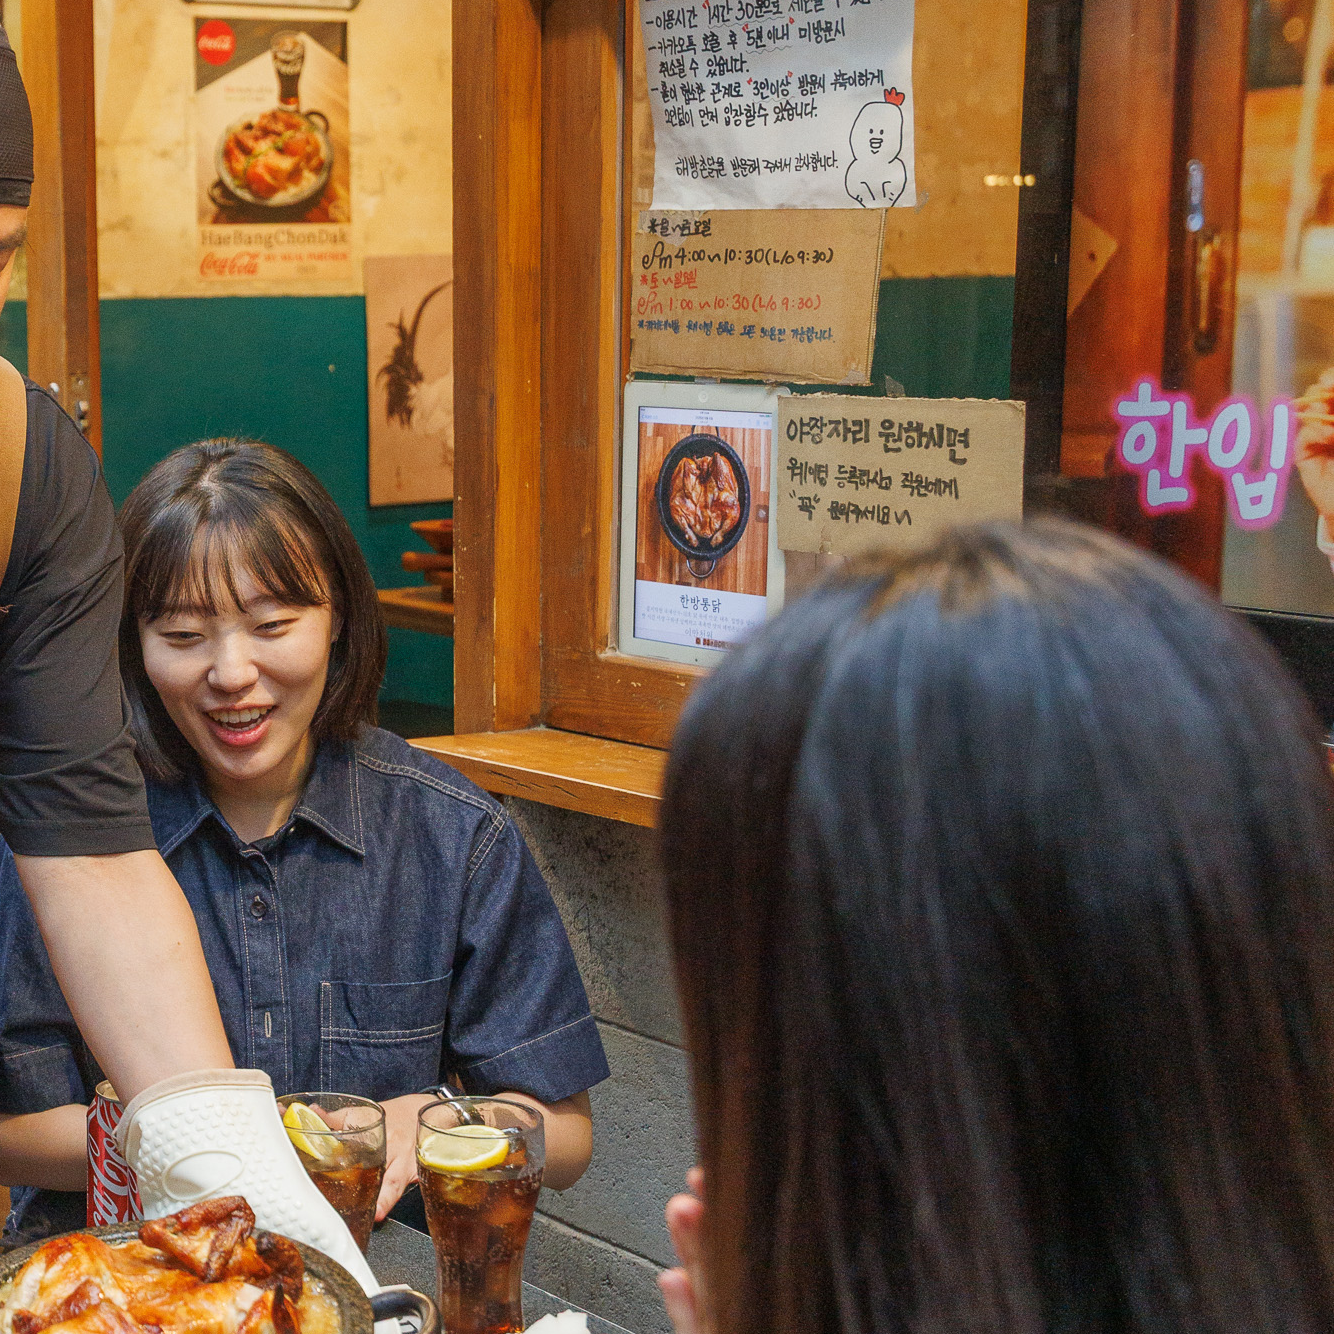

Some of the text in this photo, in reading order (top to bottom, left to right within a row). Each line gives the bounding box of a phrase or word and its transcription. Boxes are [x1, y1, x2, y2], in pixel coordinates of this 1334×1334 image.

[726, 29, 738, 50] 후
[797, 16, 846, 46] 미방문시
[688, 59, 700, 77] 수
[705, 53, 750, 78] 있습니다.
[710, 81, 744, 103] 관계로
[797, 73, 826, 97] 방문시
[698, 107, 719, 128] 먼저
[773, 99, 818, 125] 있습니다.
[730, 156, 761, 179] 방문해
[762, 156, 792, 175] 주셔서
[794, 150, 839, 174] 감사합니다.
[878, 417, 971, 466] 원하시면
[1117, 381, 1289, 521] 한입
[900, 469, 960, 501] 직원에게
[679, 593, 723, 614] 한방통닭
